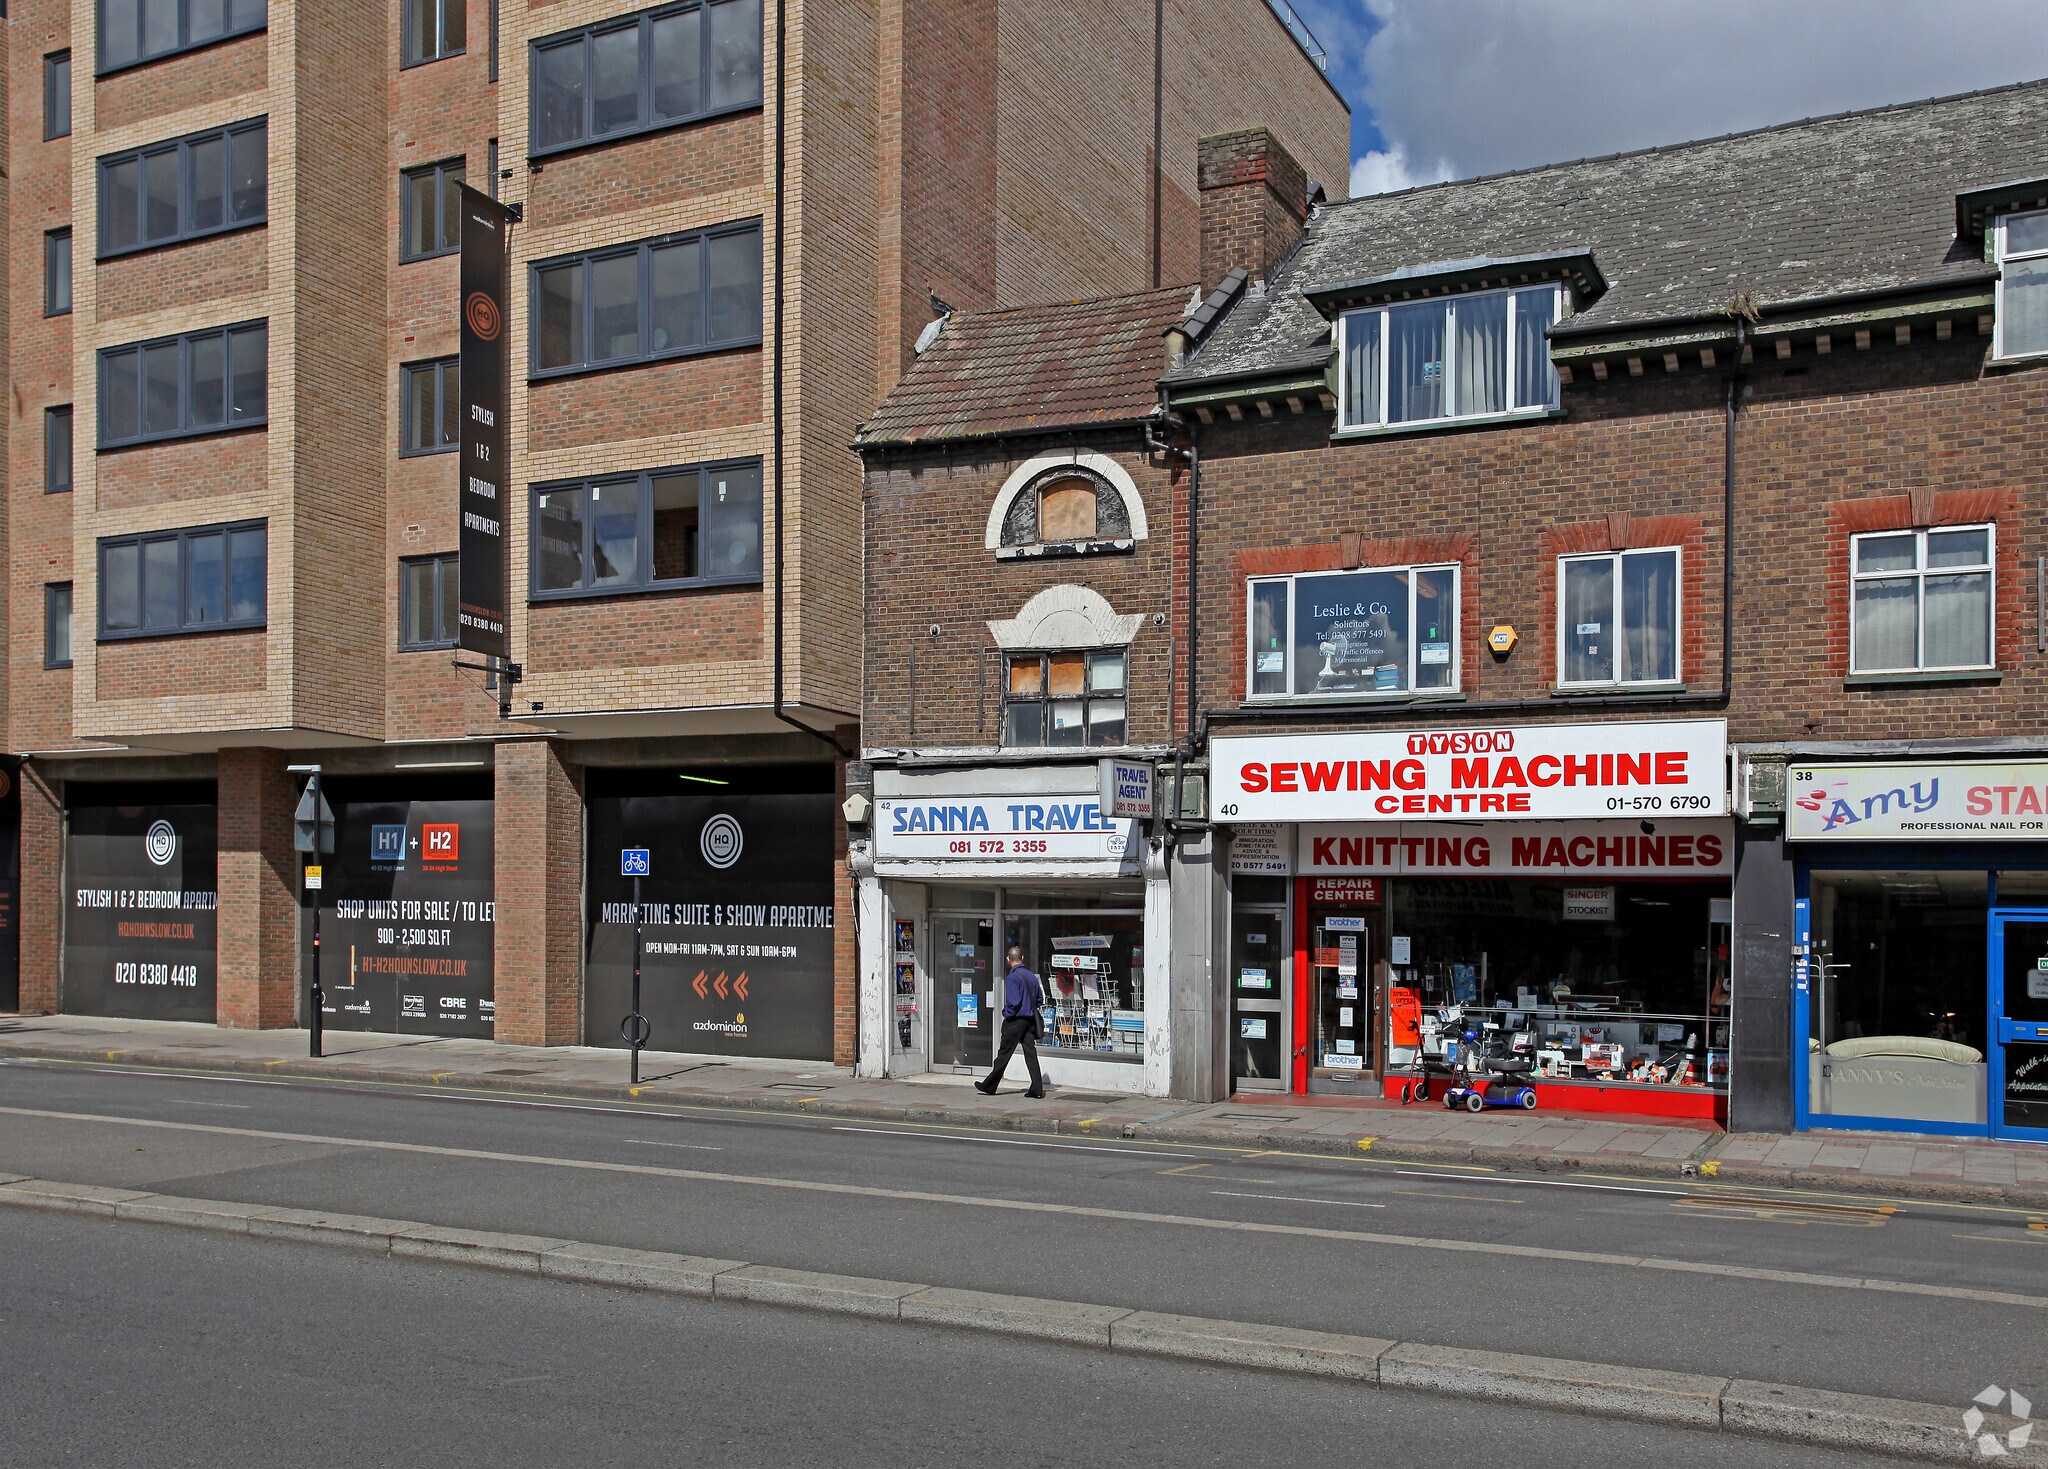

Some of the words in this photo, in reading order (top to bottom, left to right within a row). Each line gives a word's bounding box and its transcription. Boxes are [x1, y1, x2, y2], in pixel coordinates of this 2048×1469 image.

[477, 308, 490, 321] HQ
[472, 404, 494, 428] STYLISH
[476, 442, 479, 458] 1
[480, 444, 484, 460] &
[485, 446, 490, 462] 2
[469, 476, 496, 500] BEDROOM
[464, 511, 500, 537] APARTMENTS
[1313, 603, 1350, 618] Leslie
[1354, 602, 1366, 616] &
[1369, 602, 1391, 614] Co.
[460, 613, 472, 626] 020
[473, 617, 489, 630] 8380
[490, 621, 504, 634] 4418
[1334, 620, 1370, 628] Solicitors
[1316, 632, 1330, 640] Tel.
[1332, 631, 1350, 640] 0208
[1352, 630, 1366, 639] 577
[1368, 629, 1387, 638] 5491
[1494, 634, 1508, 642] ADT
[1409, 732, 1512, 754] TYSON
[1116, 767, 1148, 784] TRAVEL
[1240, 759, 1426, 794] SEWING
[1451, 752, 1689, 789] MACHINE
[1796, 772, 1813, 781] 38
[1118, 784, 1147, 800] AGENT
[880, 802, 891, 810] 42
[1116, 802, 1126, 810] 081
[1127, 804, 1136, 812] 572
[1138, 804, 1150, 812] 3355
[1220, 804, 1239, 816] 40
[1606, 796, 1662, 810] 01-570
[1669, 795, 1712, 810] 6790
[1374, 792, 1531, 814] CENTRE
[1822, 777, 1939, 832] Amy
[892, 806, 990, 832] SANNA
[1006, 804, 1116, 832] TRAVEL
[1990, 822, 2016, 830] NAIL
[2020, 822, 2043, 830] FOR
[156, 837, 166, 845] HQ
[379, 832, 398, 850] H1
[430, 832, 451, 850] H2
[714, 834, 729, 844] HQ
[950, 840, 971, 853] 081
[979, 840, 1004, 853] 572
[1012, 840, 1047, 852] 3355
[1312, 836, 1490, 867] KNITTING
[1511, 834, 1723, 868] MACHINES
[1316, 878, 1372, 889] REPAIR
[77, 890, 112, 908] STYLISH
[114, 890, 118, 908] 1
[120, 890, 127, 908] &
[129, 890, 135, 908] 2
[138, 891, 181, 909] BEDROOM
[1314, 890, 1375, 900] CENTRE
[1568, 890, 1608, 900] SINGER
[337, 900, 365, 919] SHOP
[368, 900, 398, 920] UNITS
[402, 901, 421, 920] FOR
[424, 901, 450, 921] SALE
[452, 900, 459, 922] /
[462, 902, 476, 922] TO
[480, 902, 496, 922] LET
[602, 902, 670, 925] MARKTING
[674, 904, 710, 926] SUITE
[714, 905, 722, 926] &
[727, 905, 766, 927] SHOW
[770, 906, 835, 928] APARTME
[1567, 906, 1609, 916] STOCKIST
[1329, 918, 1361, 926] brother
[118, 922, 194, 939] HQHOUNSLOW.CO.UK
[377, 928, 394, 944] 900
[402, 928, 425, 946] 2,500
[428, 929, 440, 946] SQ
[442, 930, 451, 946] FT
[646, 942, 662, 954] OPEN
[663, 942, 690, 955] MON-FRI
[691, 943, 726, 957] 11AM-7PM,
[726, 944, 739, 956] SAT
[740, 944, 745, 956] &
[746, 944, 760, 957] SUN
[761, 945, 797, 958] 10AM-6PM
[362, 956, 467, 976] H1-H2HOUNSLOW.CO.UK
[116, 962, 136, 984] 020
[140, 963, 168, 985] 8380
[170, 964, 197, 987] 4418
[440, 997, 466, 1008] CBRE
[693, 1020, 748, 1032] a2dominion
[1328, 1056, 1359, 1064] brother
[1822, 1064, 1904, 1086] DANNY'S
